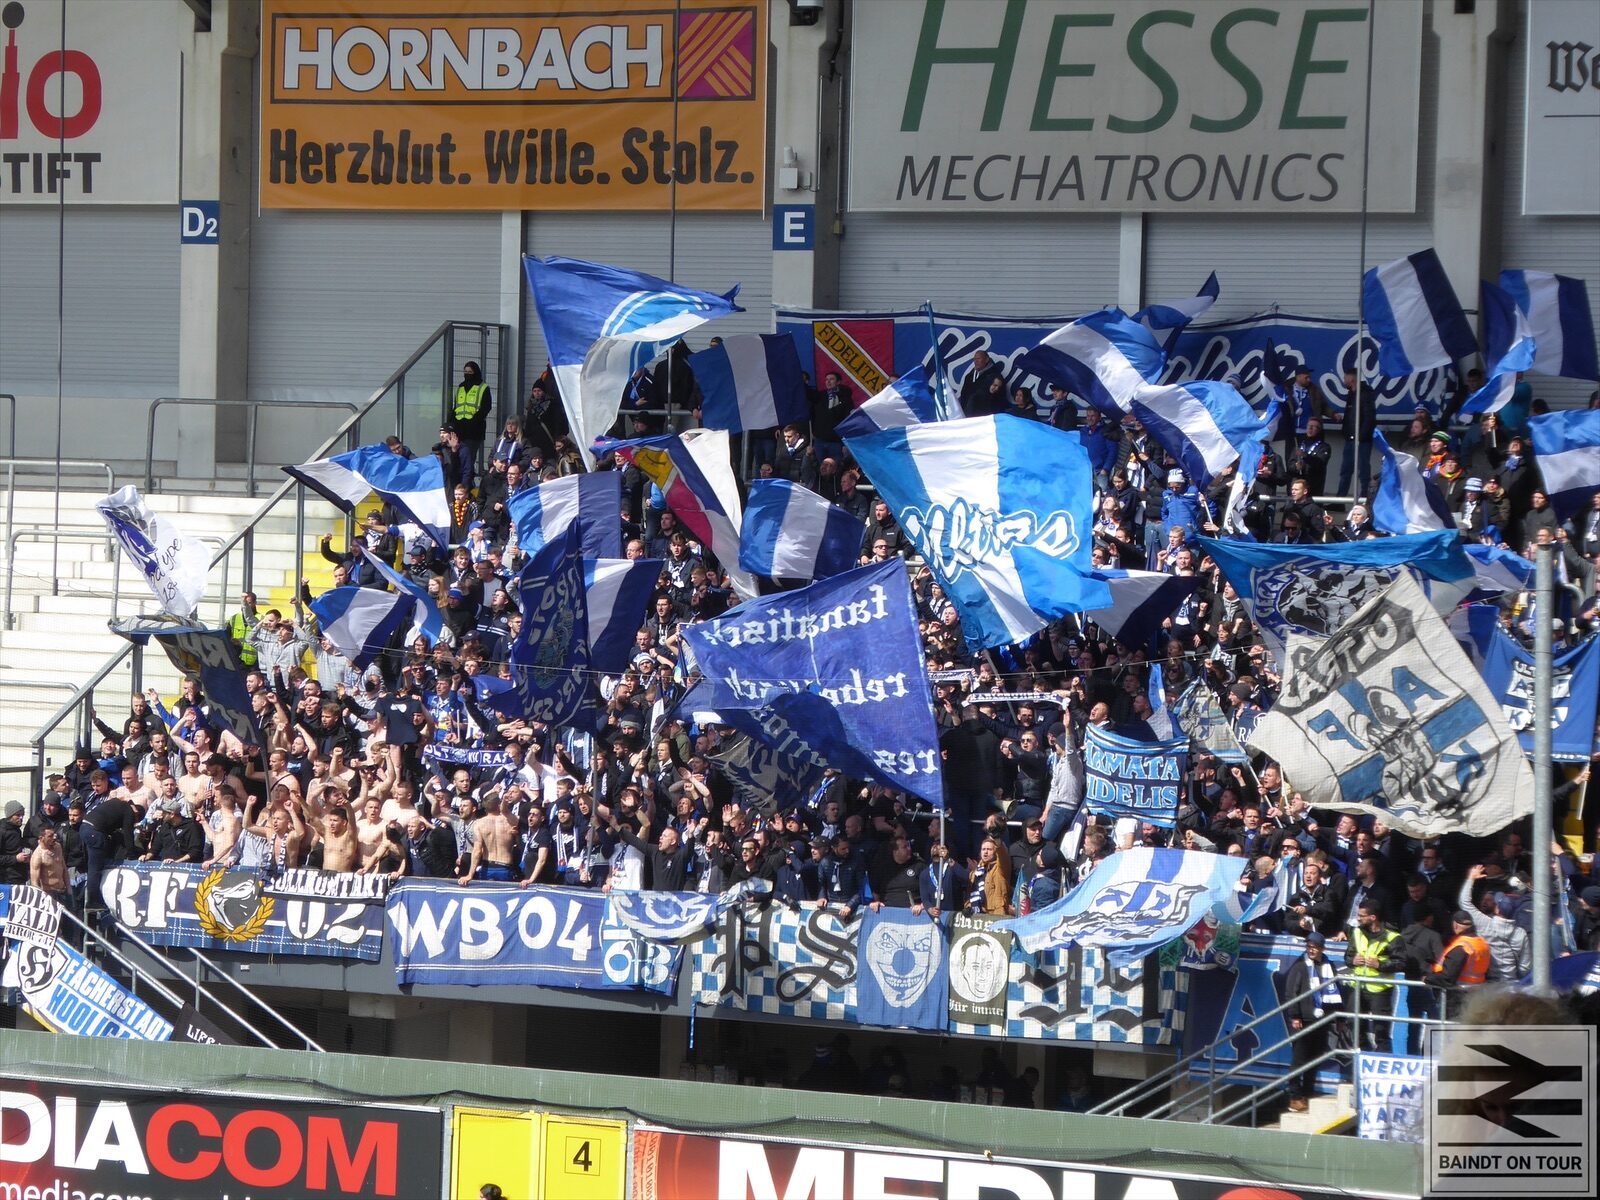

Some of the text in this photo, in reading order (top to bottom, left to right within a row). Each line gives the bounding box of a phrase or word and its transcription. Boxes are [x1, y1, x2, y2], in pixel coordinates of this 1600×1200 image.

[283, 25, 663, 91] HORNBACH
[900, 0, 1370, 134] HESSE
[268, 126, 754, 186] Herzblut. Wille. Stolz.
[896, 153, 1345, 202] MECHATRONICS
[783, 211, 806, 243] E
[1086, 772, 1178, 809] IDELIS
[572, 1140, 592, 1172] 4
